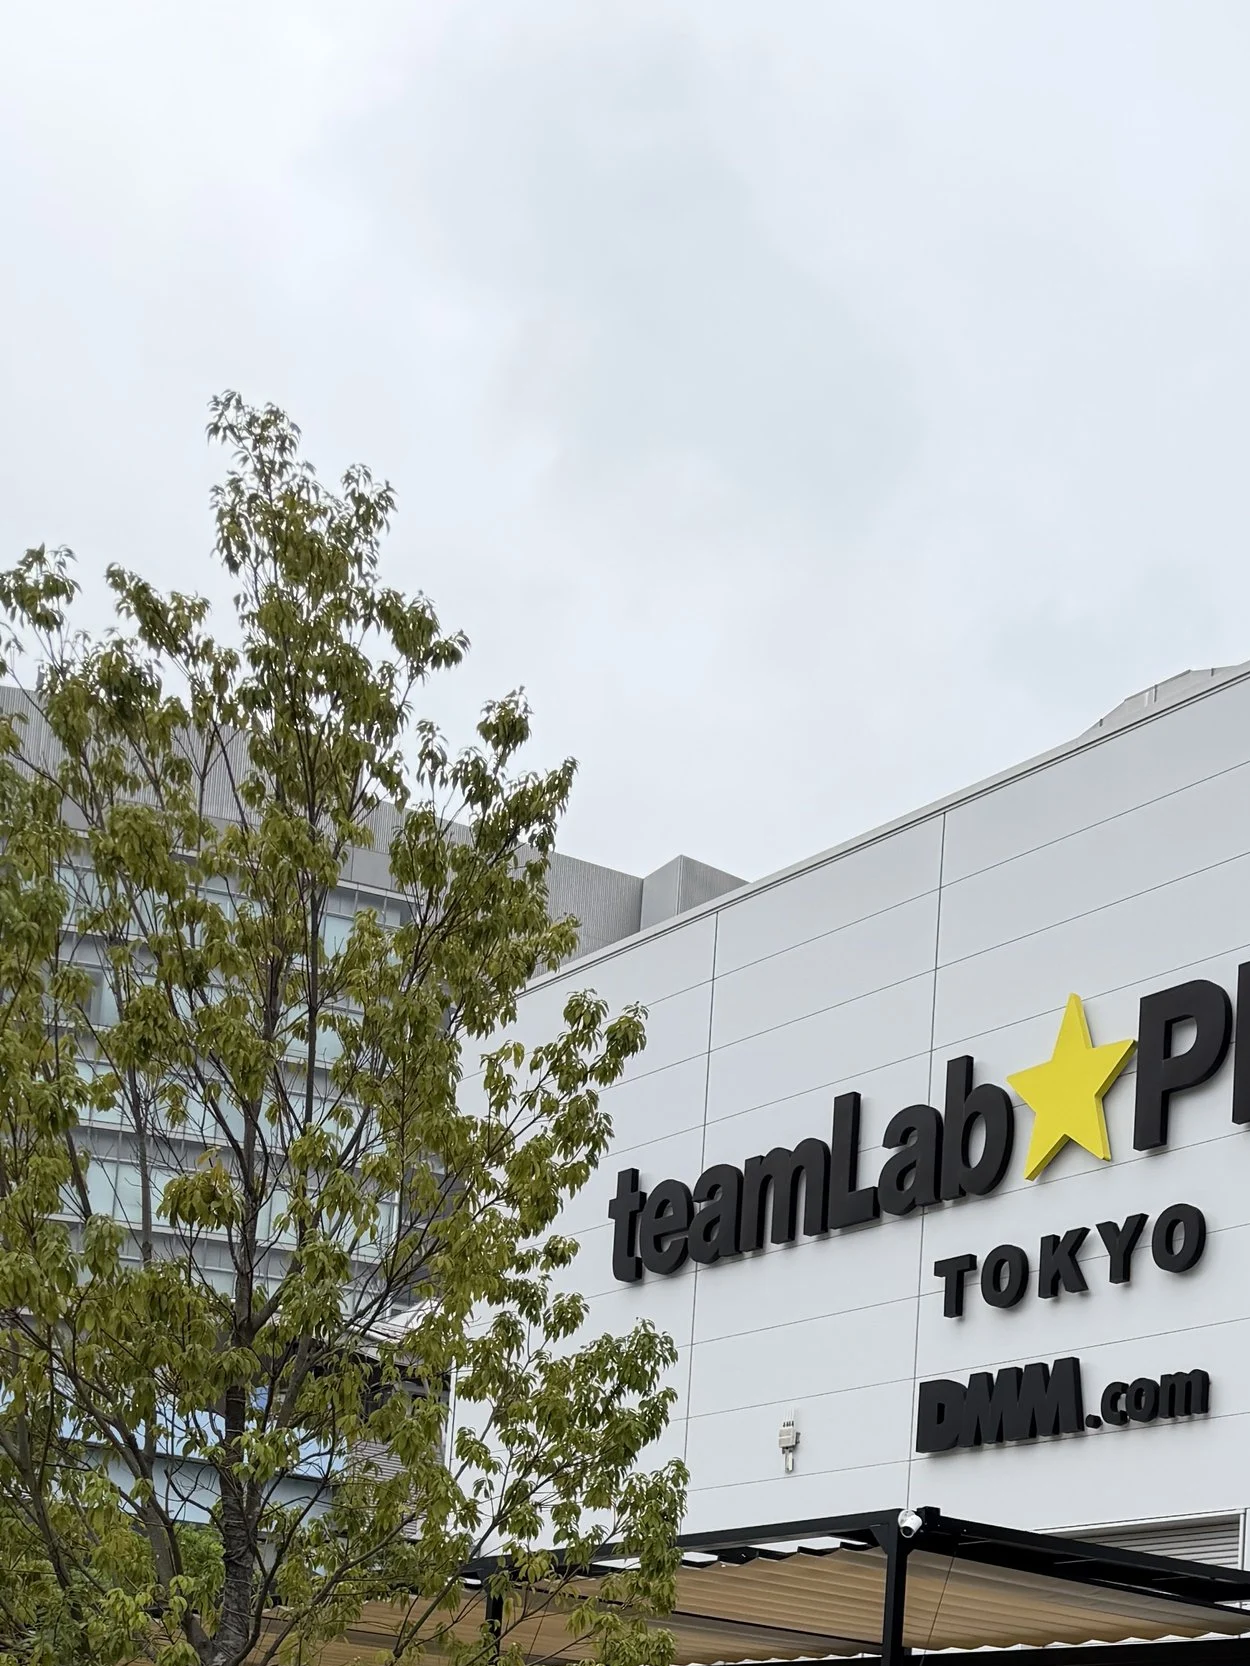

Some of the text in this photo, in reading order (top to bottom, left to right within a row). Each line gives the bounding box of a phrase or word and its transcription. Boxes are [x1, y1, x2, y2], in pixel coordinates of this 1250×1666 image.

[608, 1054, 1014, 1283] teamLab
[934, 1203, 1206, 1318] TOKYO
[915, 1357, 1210, 1454] DMM.com
